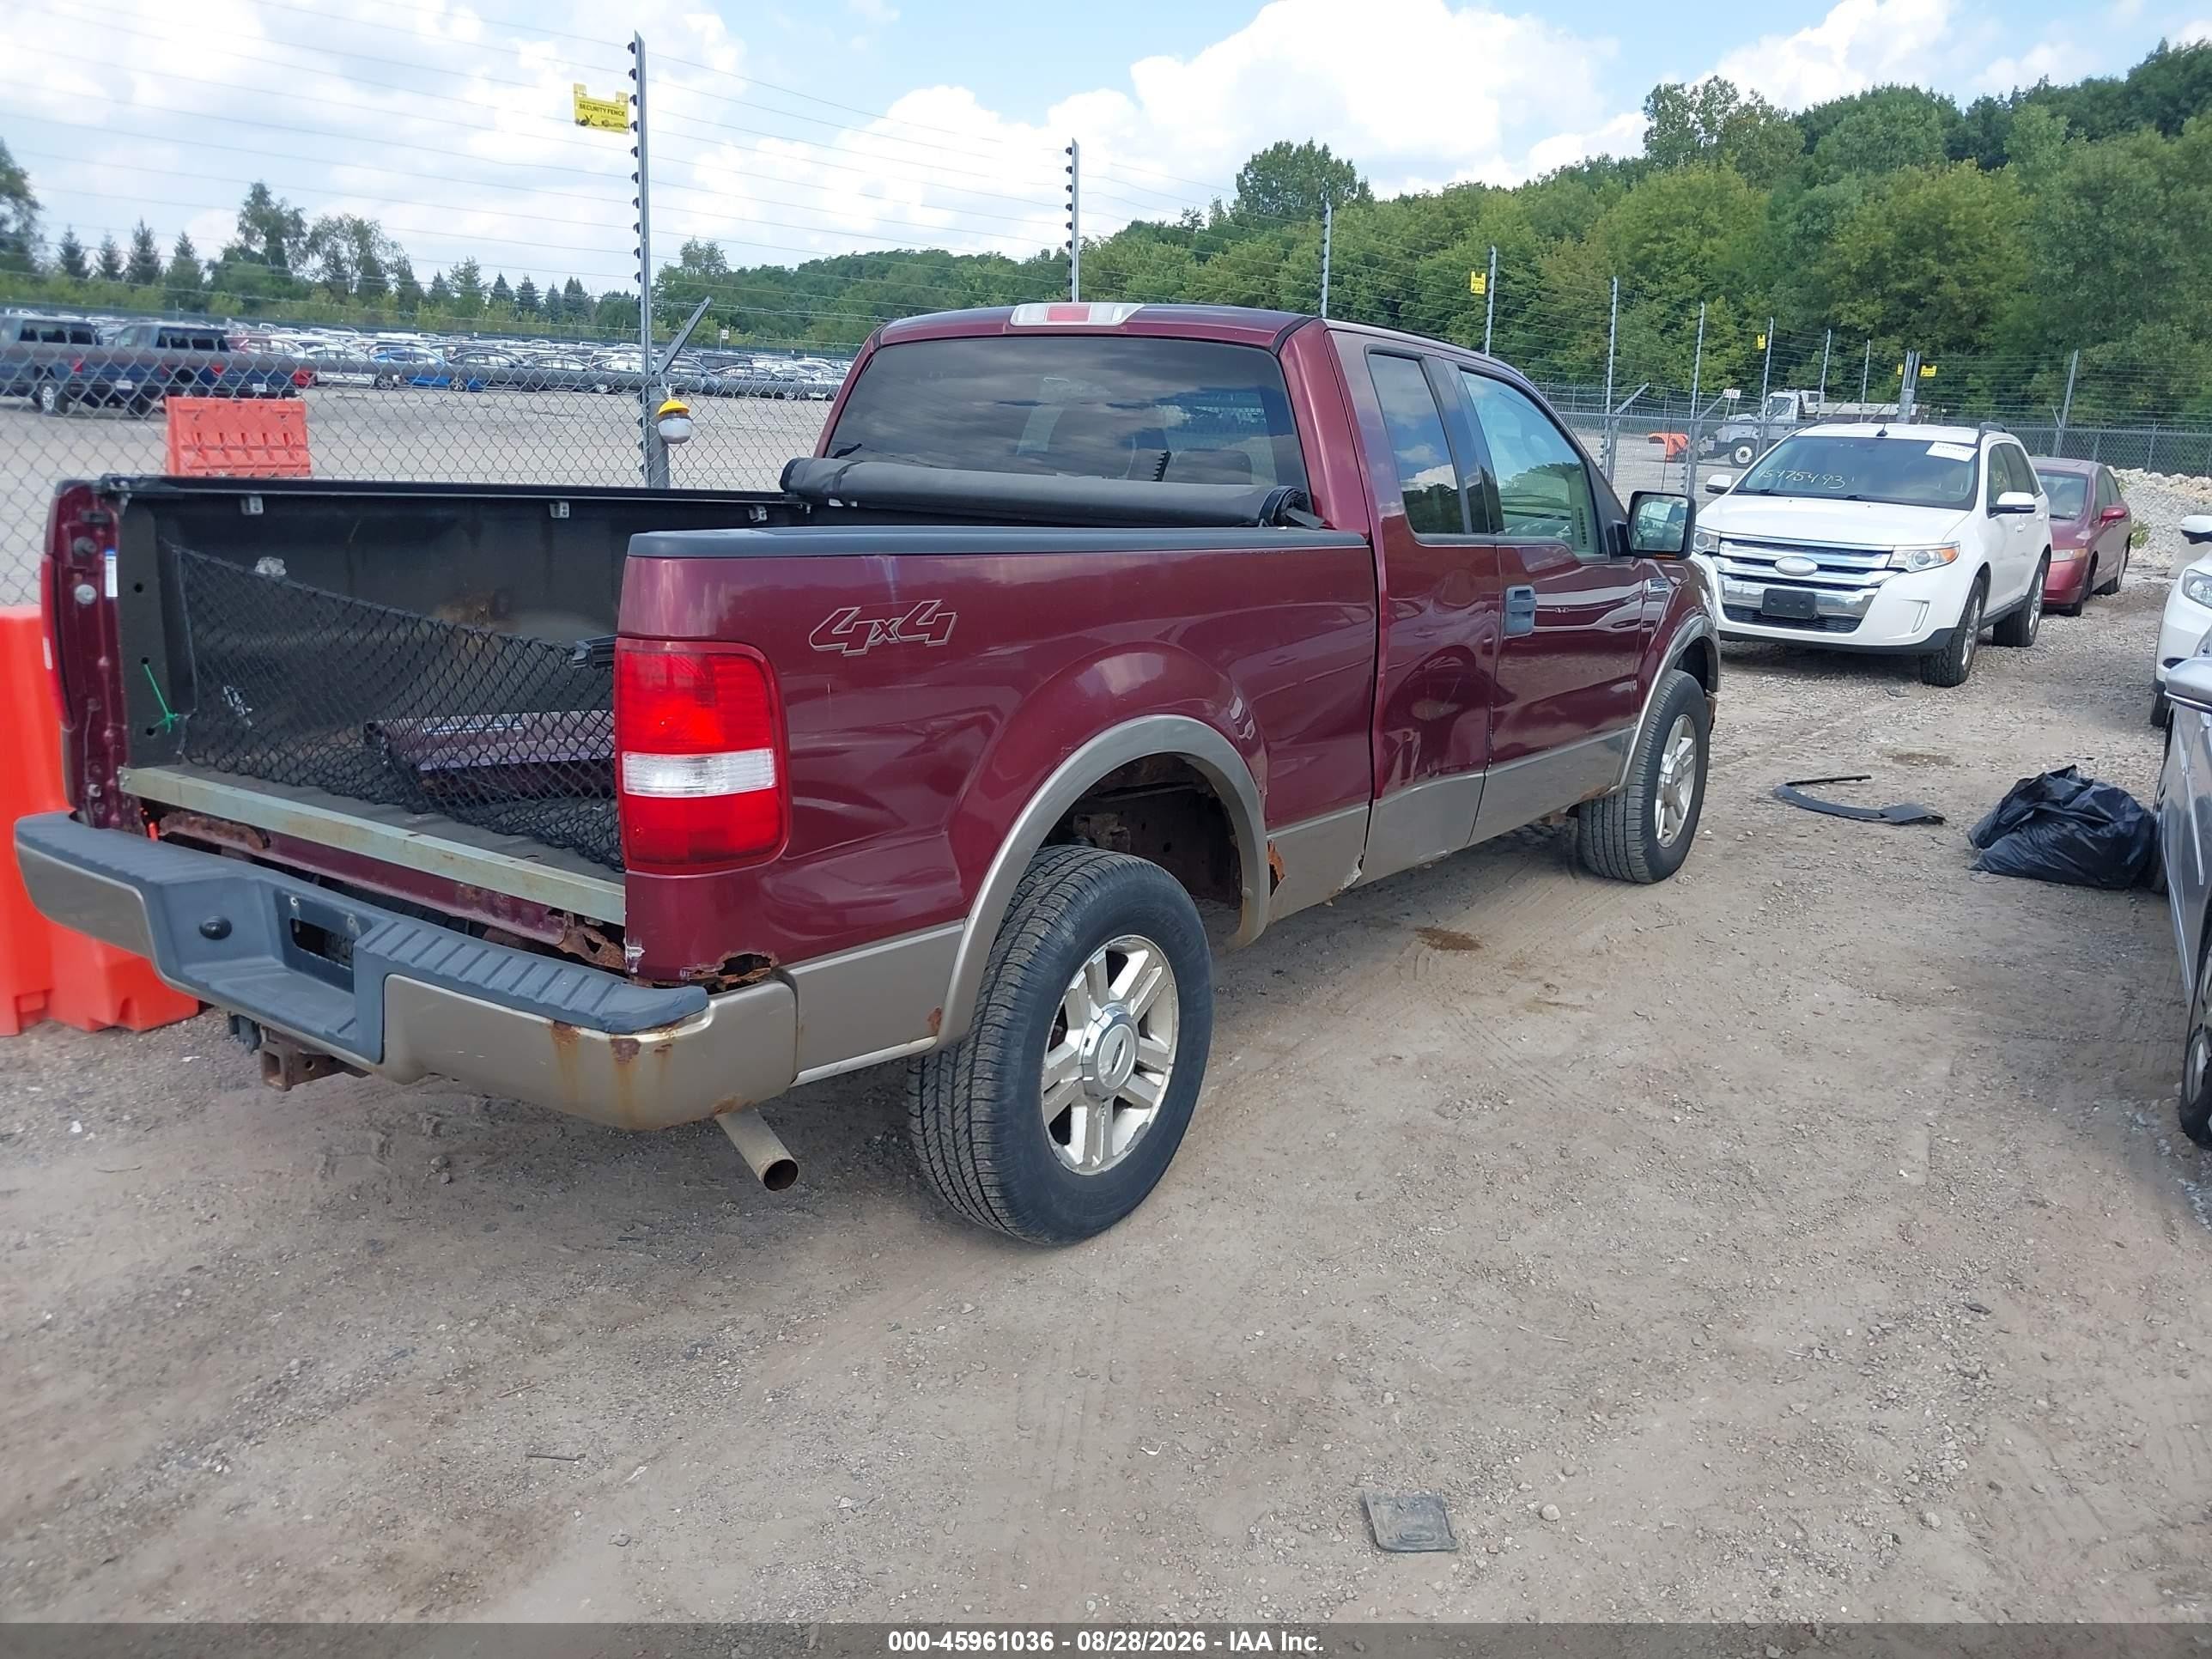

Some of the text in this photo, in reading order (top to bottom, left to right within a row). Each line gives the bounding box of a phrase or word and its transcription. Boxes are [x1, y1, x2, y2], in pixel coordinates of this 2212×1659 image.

[579, 103, 606, 113] SECURITY
[607, 108, 625, 117] FENCE
[809, 599, 957, 656] 4x4
